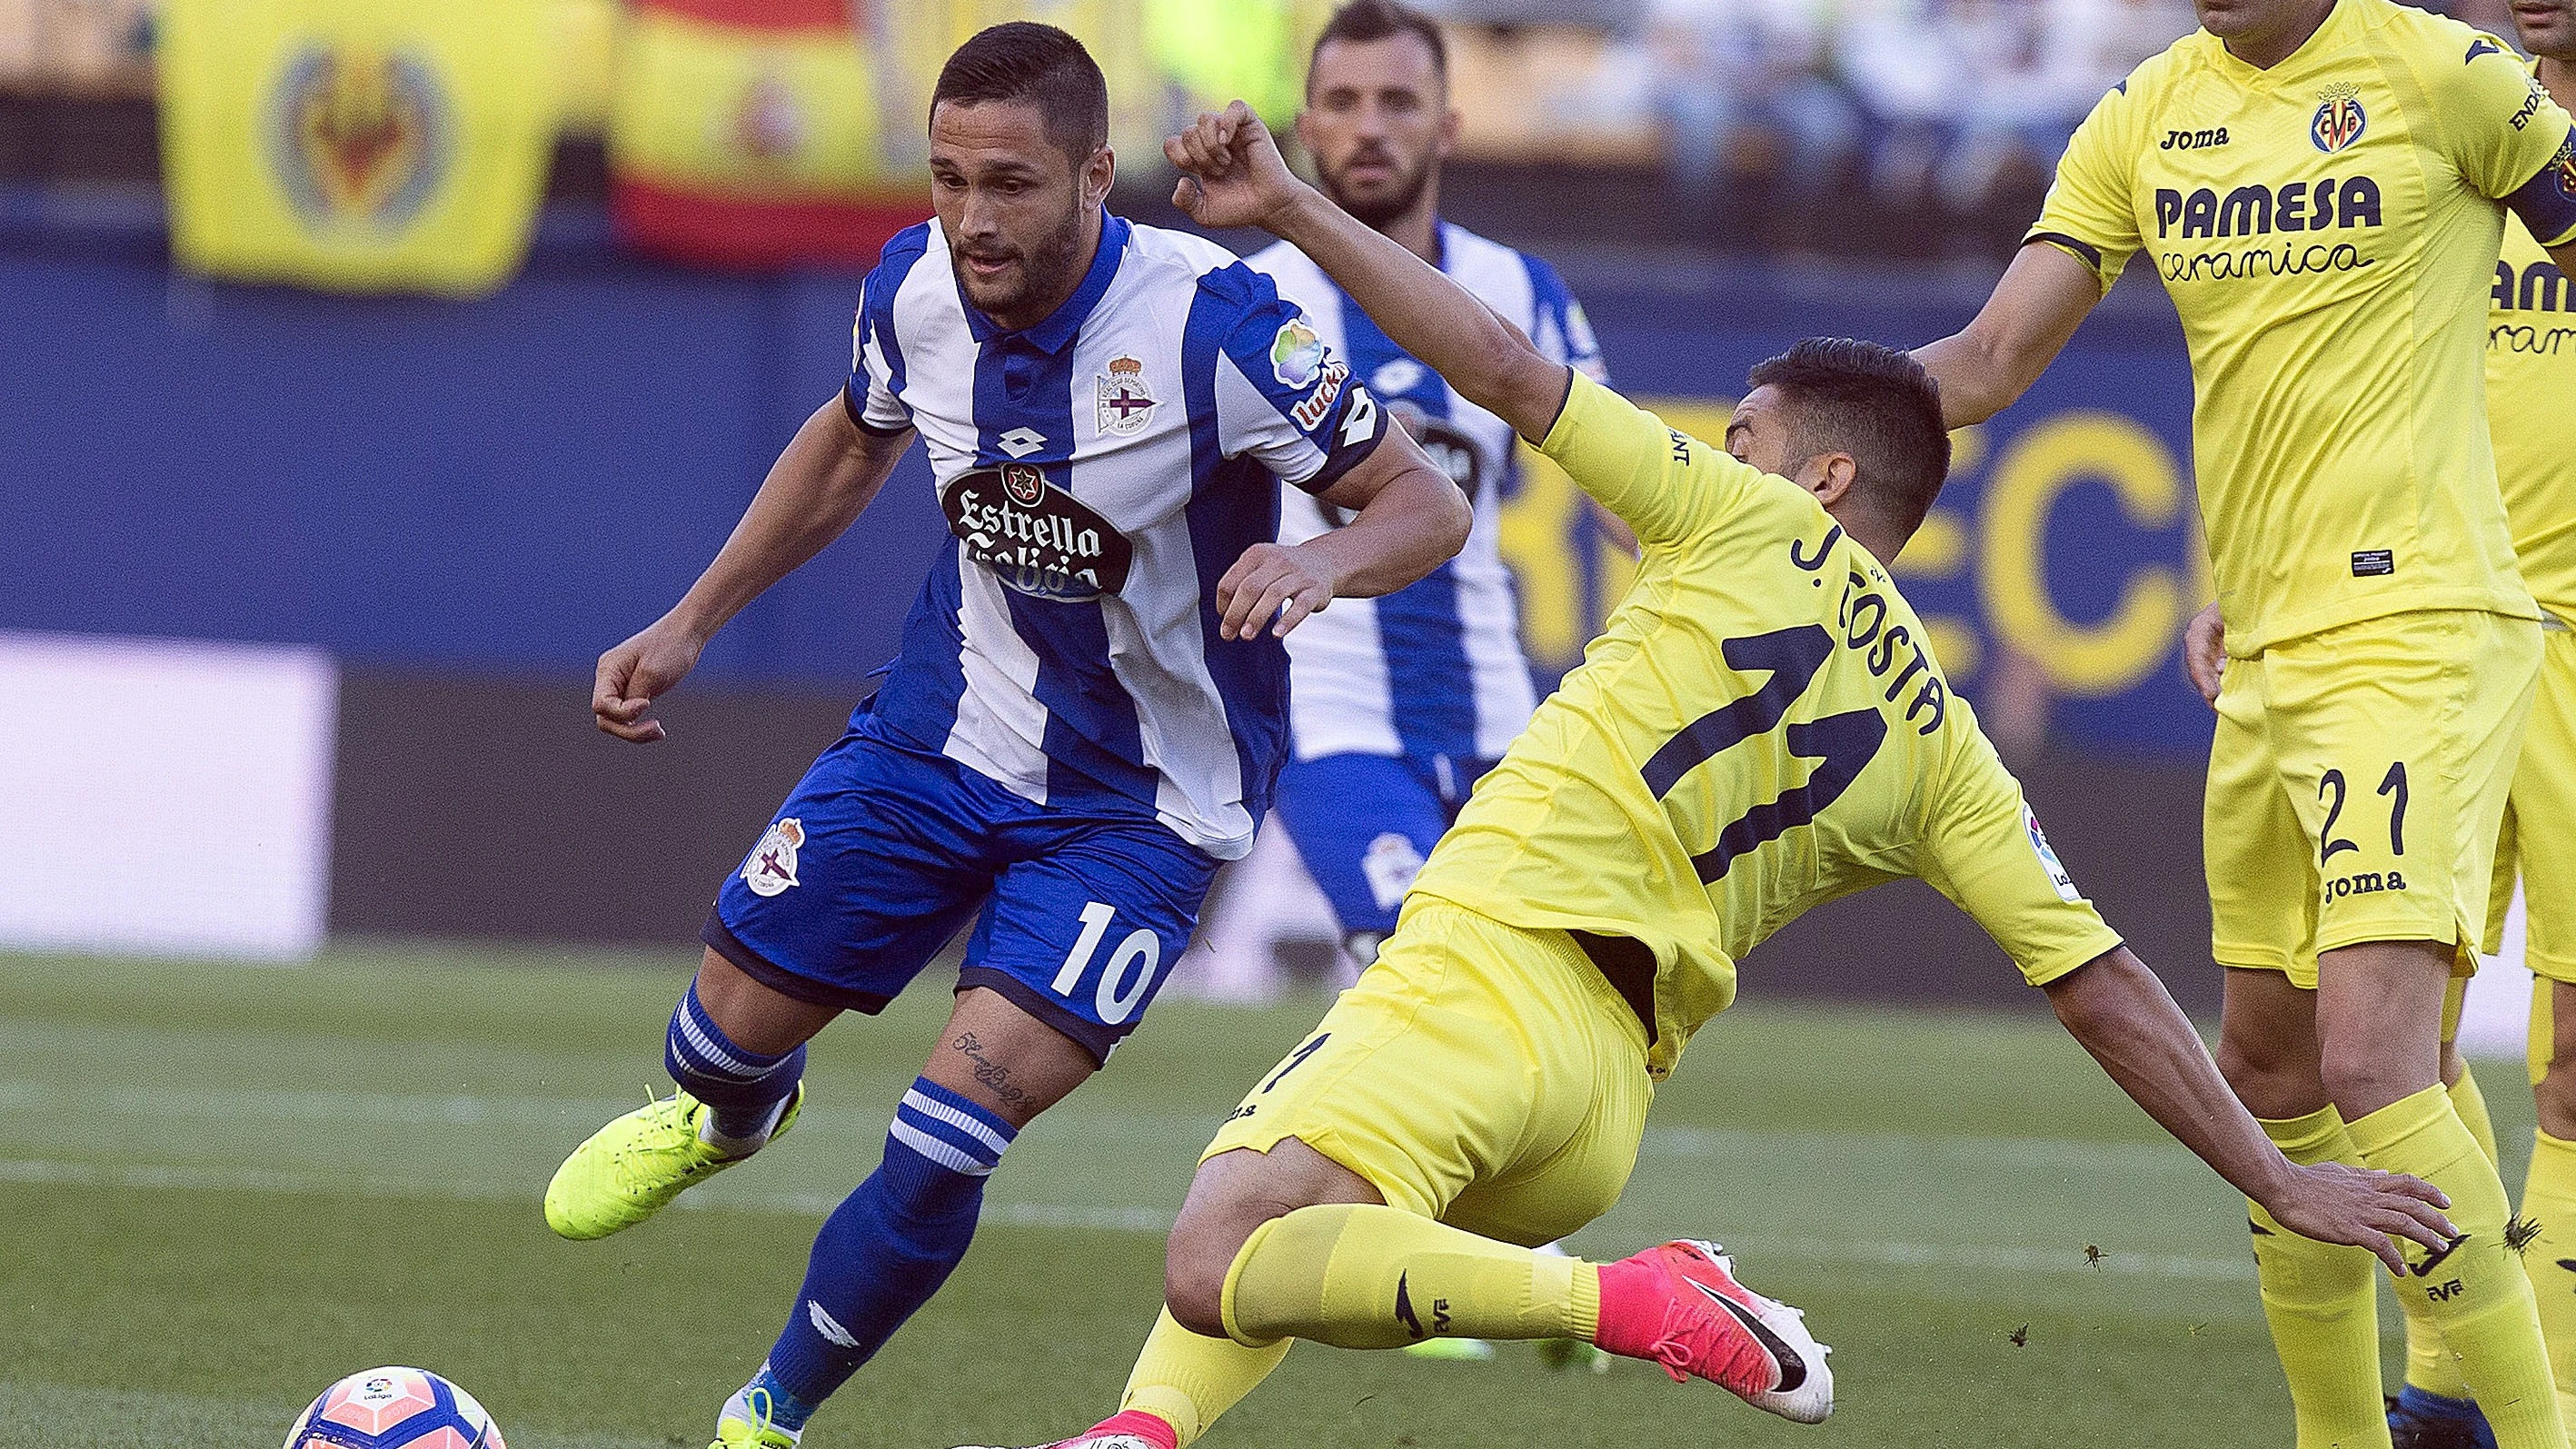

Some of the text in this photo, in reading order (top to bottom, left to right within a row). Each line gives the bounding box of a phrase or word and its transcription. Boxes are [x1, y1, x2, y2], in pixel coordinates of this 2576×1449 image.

[2154, 175, 2382, 239] PAMESA
[2161, 242, 2376, 282] ceramica
[958, 489, 1103, 558] Estrella
[1790, 524, 1944, 737] J. COSTA
[1639, 623, 1888, 887] 11
[2318, 760, 2409, 868] 21
[1050, 900, 1160, 1026] 10
